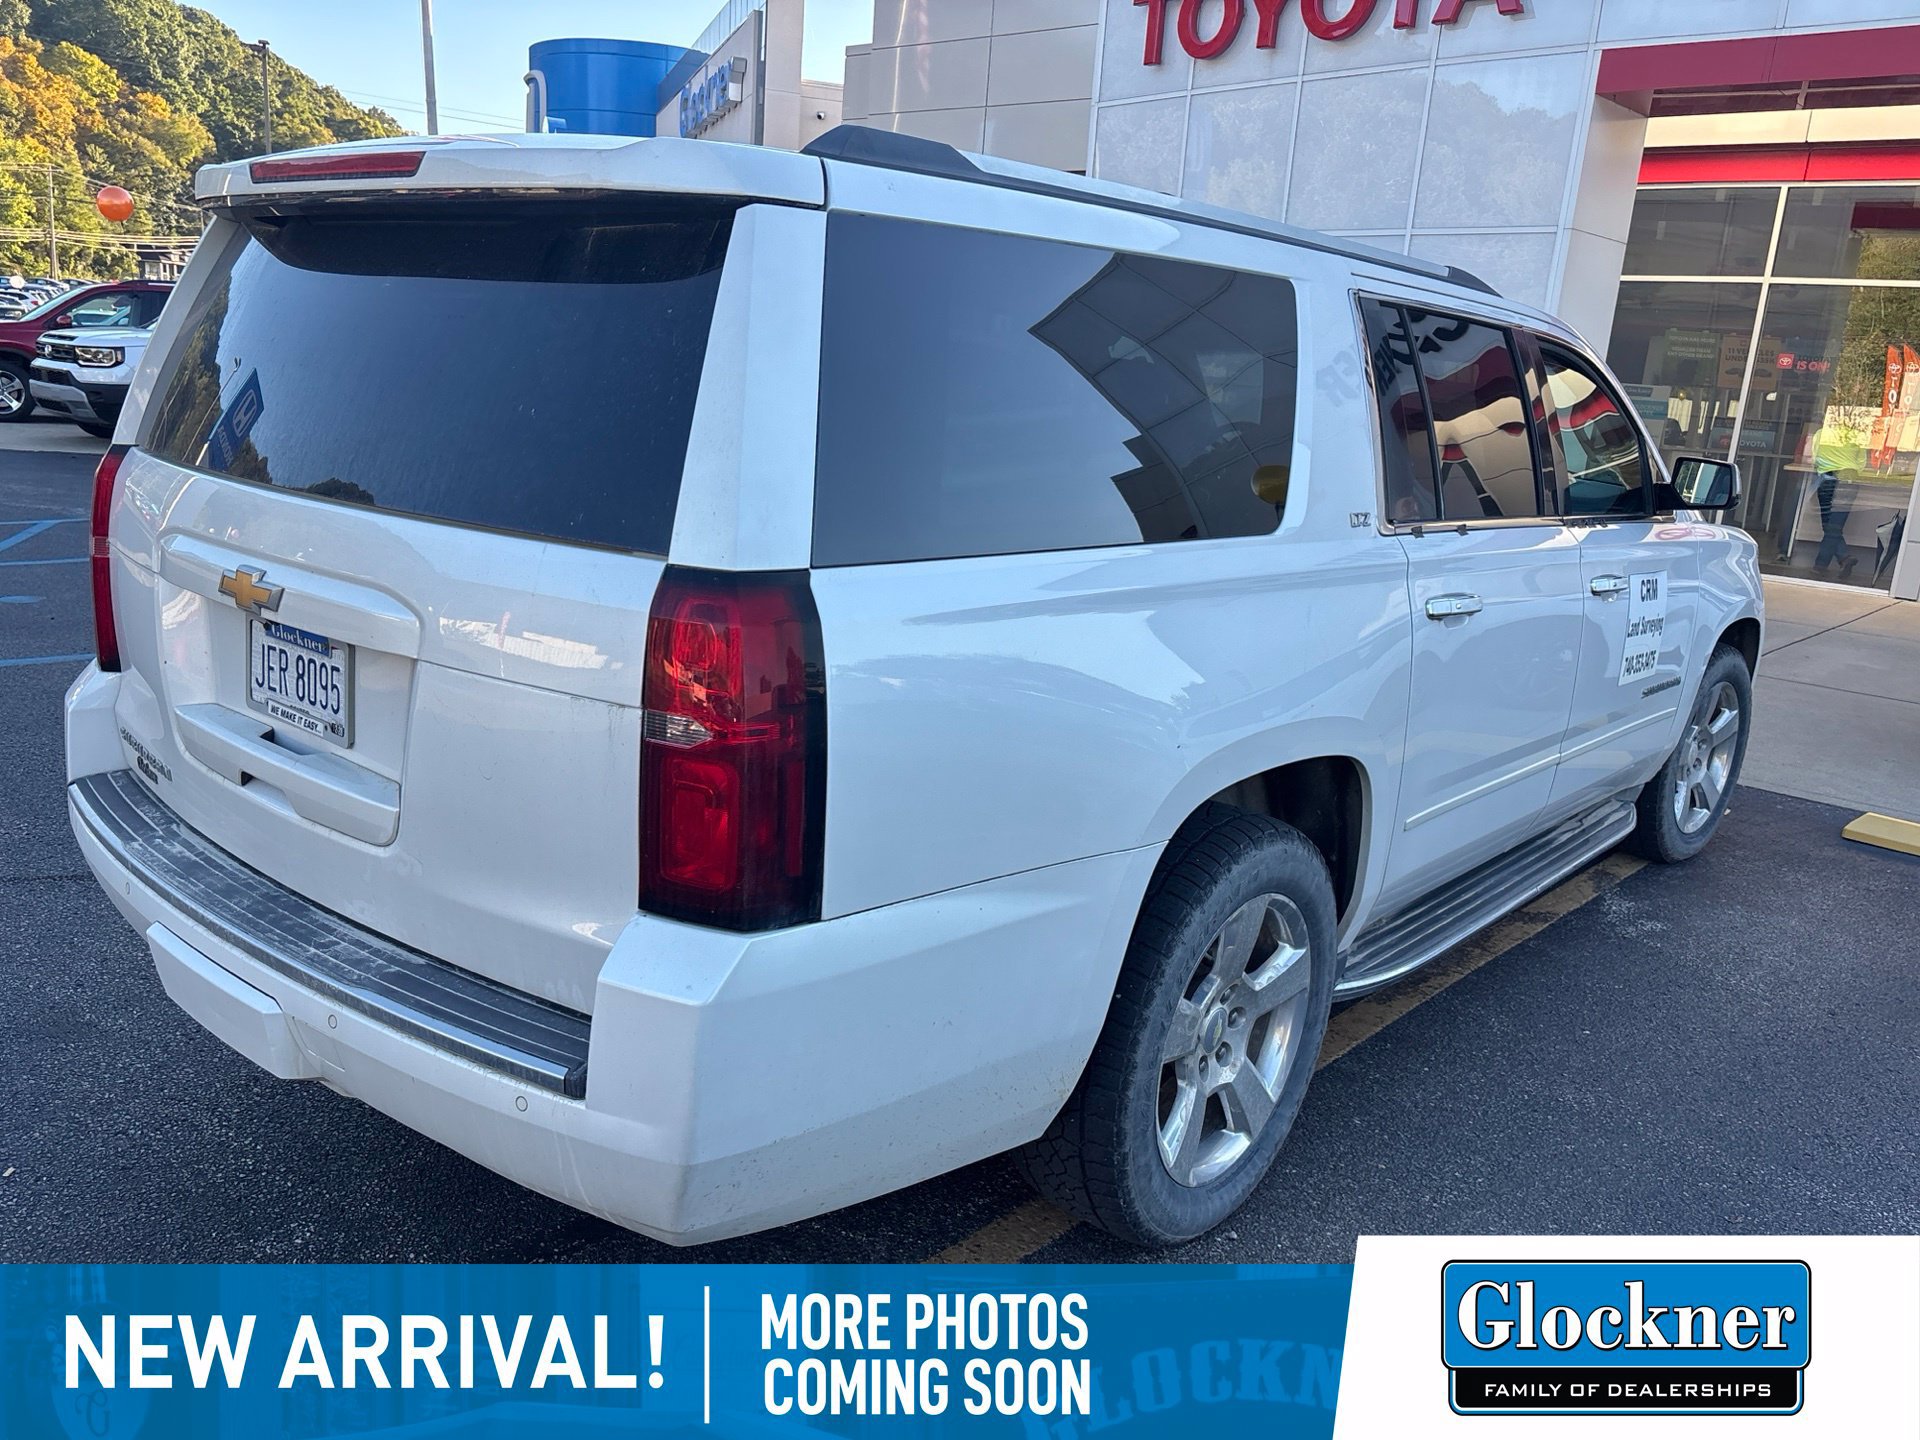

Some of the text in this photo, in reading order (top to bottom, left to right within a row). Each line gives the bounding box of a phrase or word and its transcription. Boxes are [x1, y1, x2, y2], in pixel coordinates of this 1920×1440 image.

[1133, 0, 1524, 66] TOYO
[1640, 578, 1658, 602] CRM
[271, 623, 326, 652] Glockner
[1627, 613, 1664, 638] Land Surveying
[255, 643, 340, 715] JER 8095
[270, 704, 280, 716] WE
[280, 707, 296, 723] MAKE
[297, 715, 303, 725] IT
